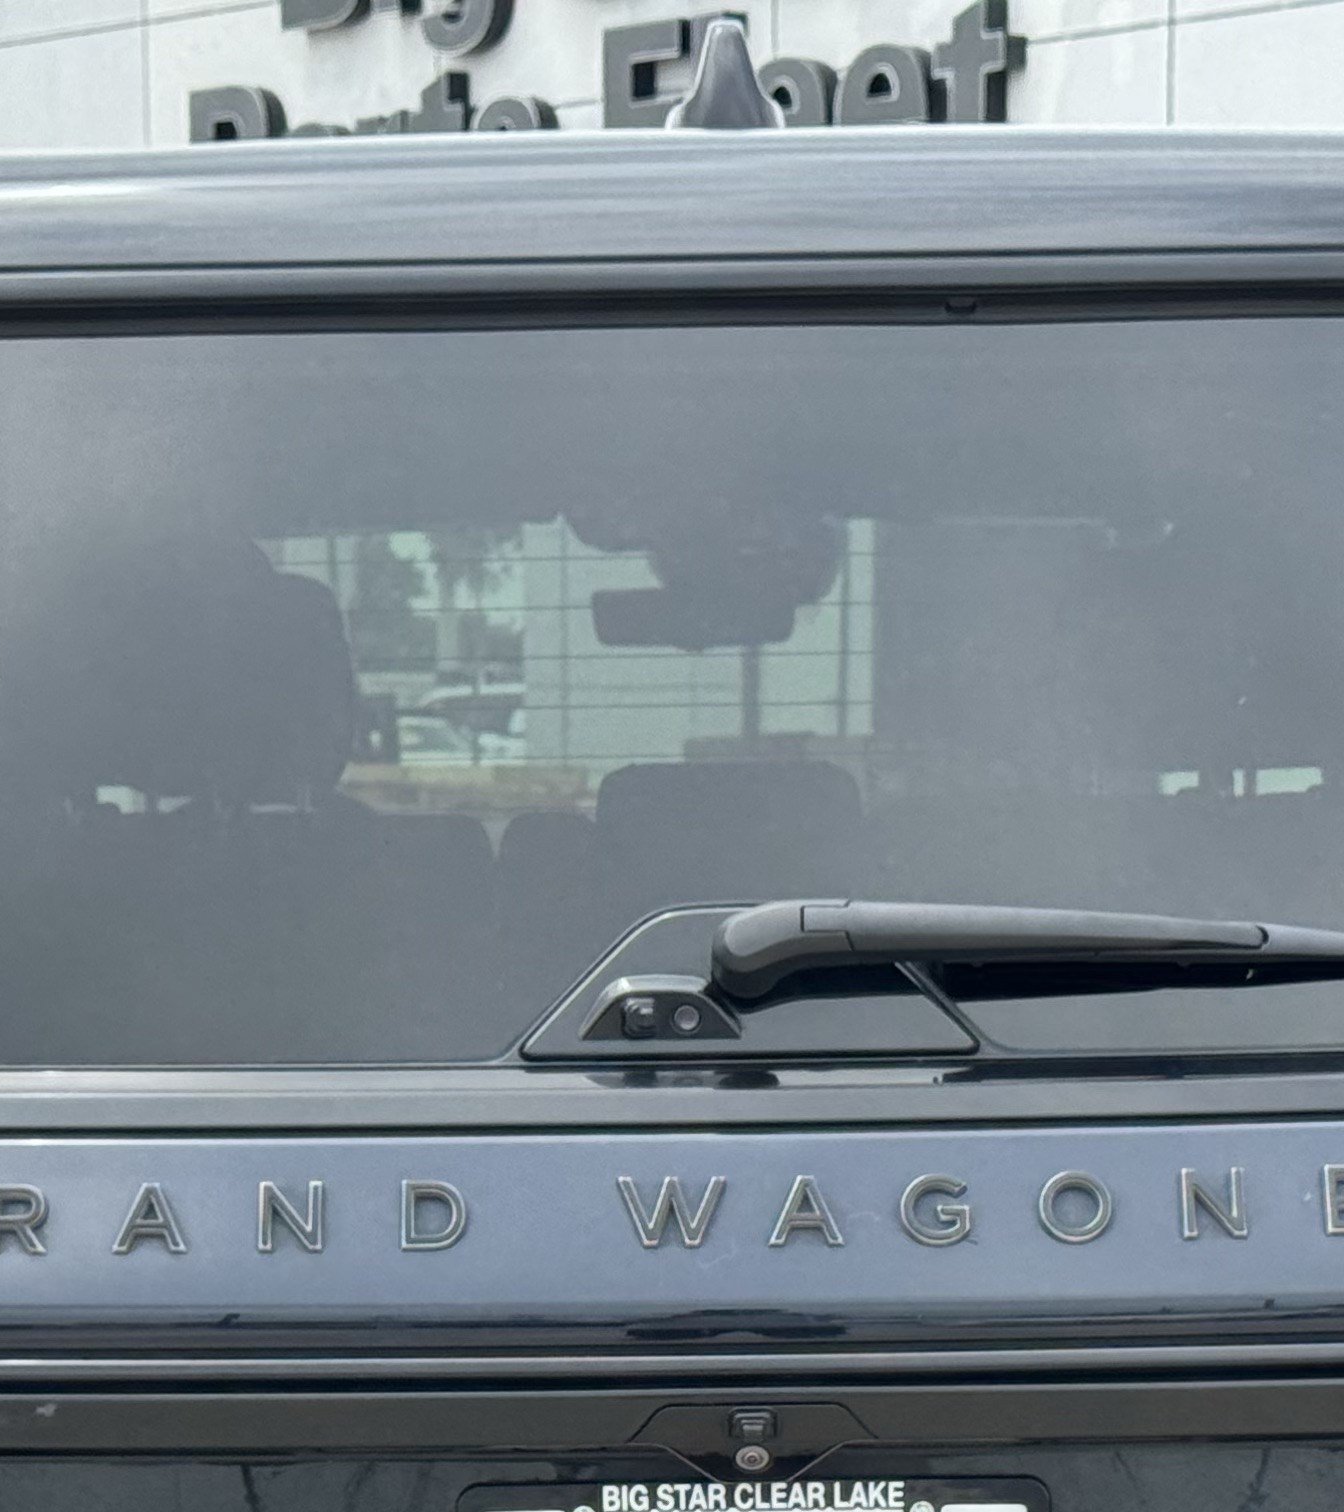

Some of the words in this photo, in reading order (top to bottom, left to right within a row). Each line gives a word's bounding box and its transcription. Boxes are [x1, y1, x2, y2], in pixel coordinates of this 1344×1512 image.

[601, 1484, 649, 1512] BIG
[656, 1483, 727, 1511] STAR
[734, 1482, 826, 1510] CLEAR
[833, 1480, 906, 1508] LAKE
